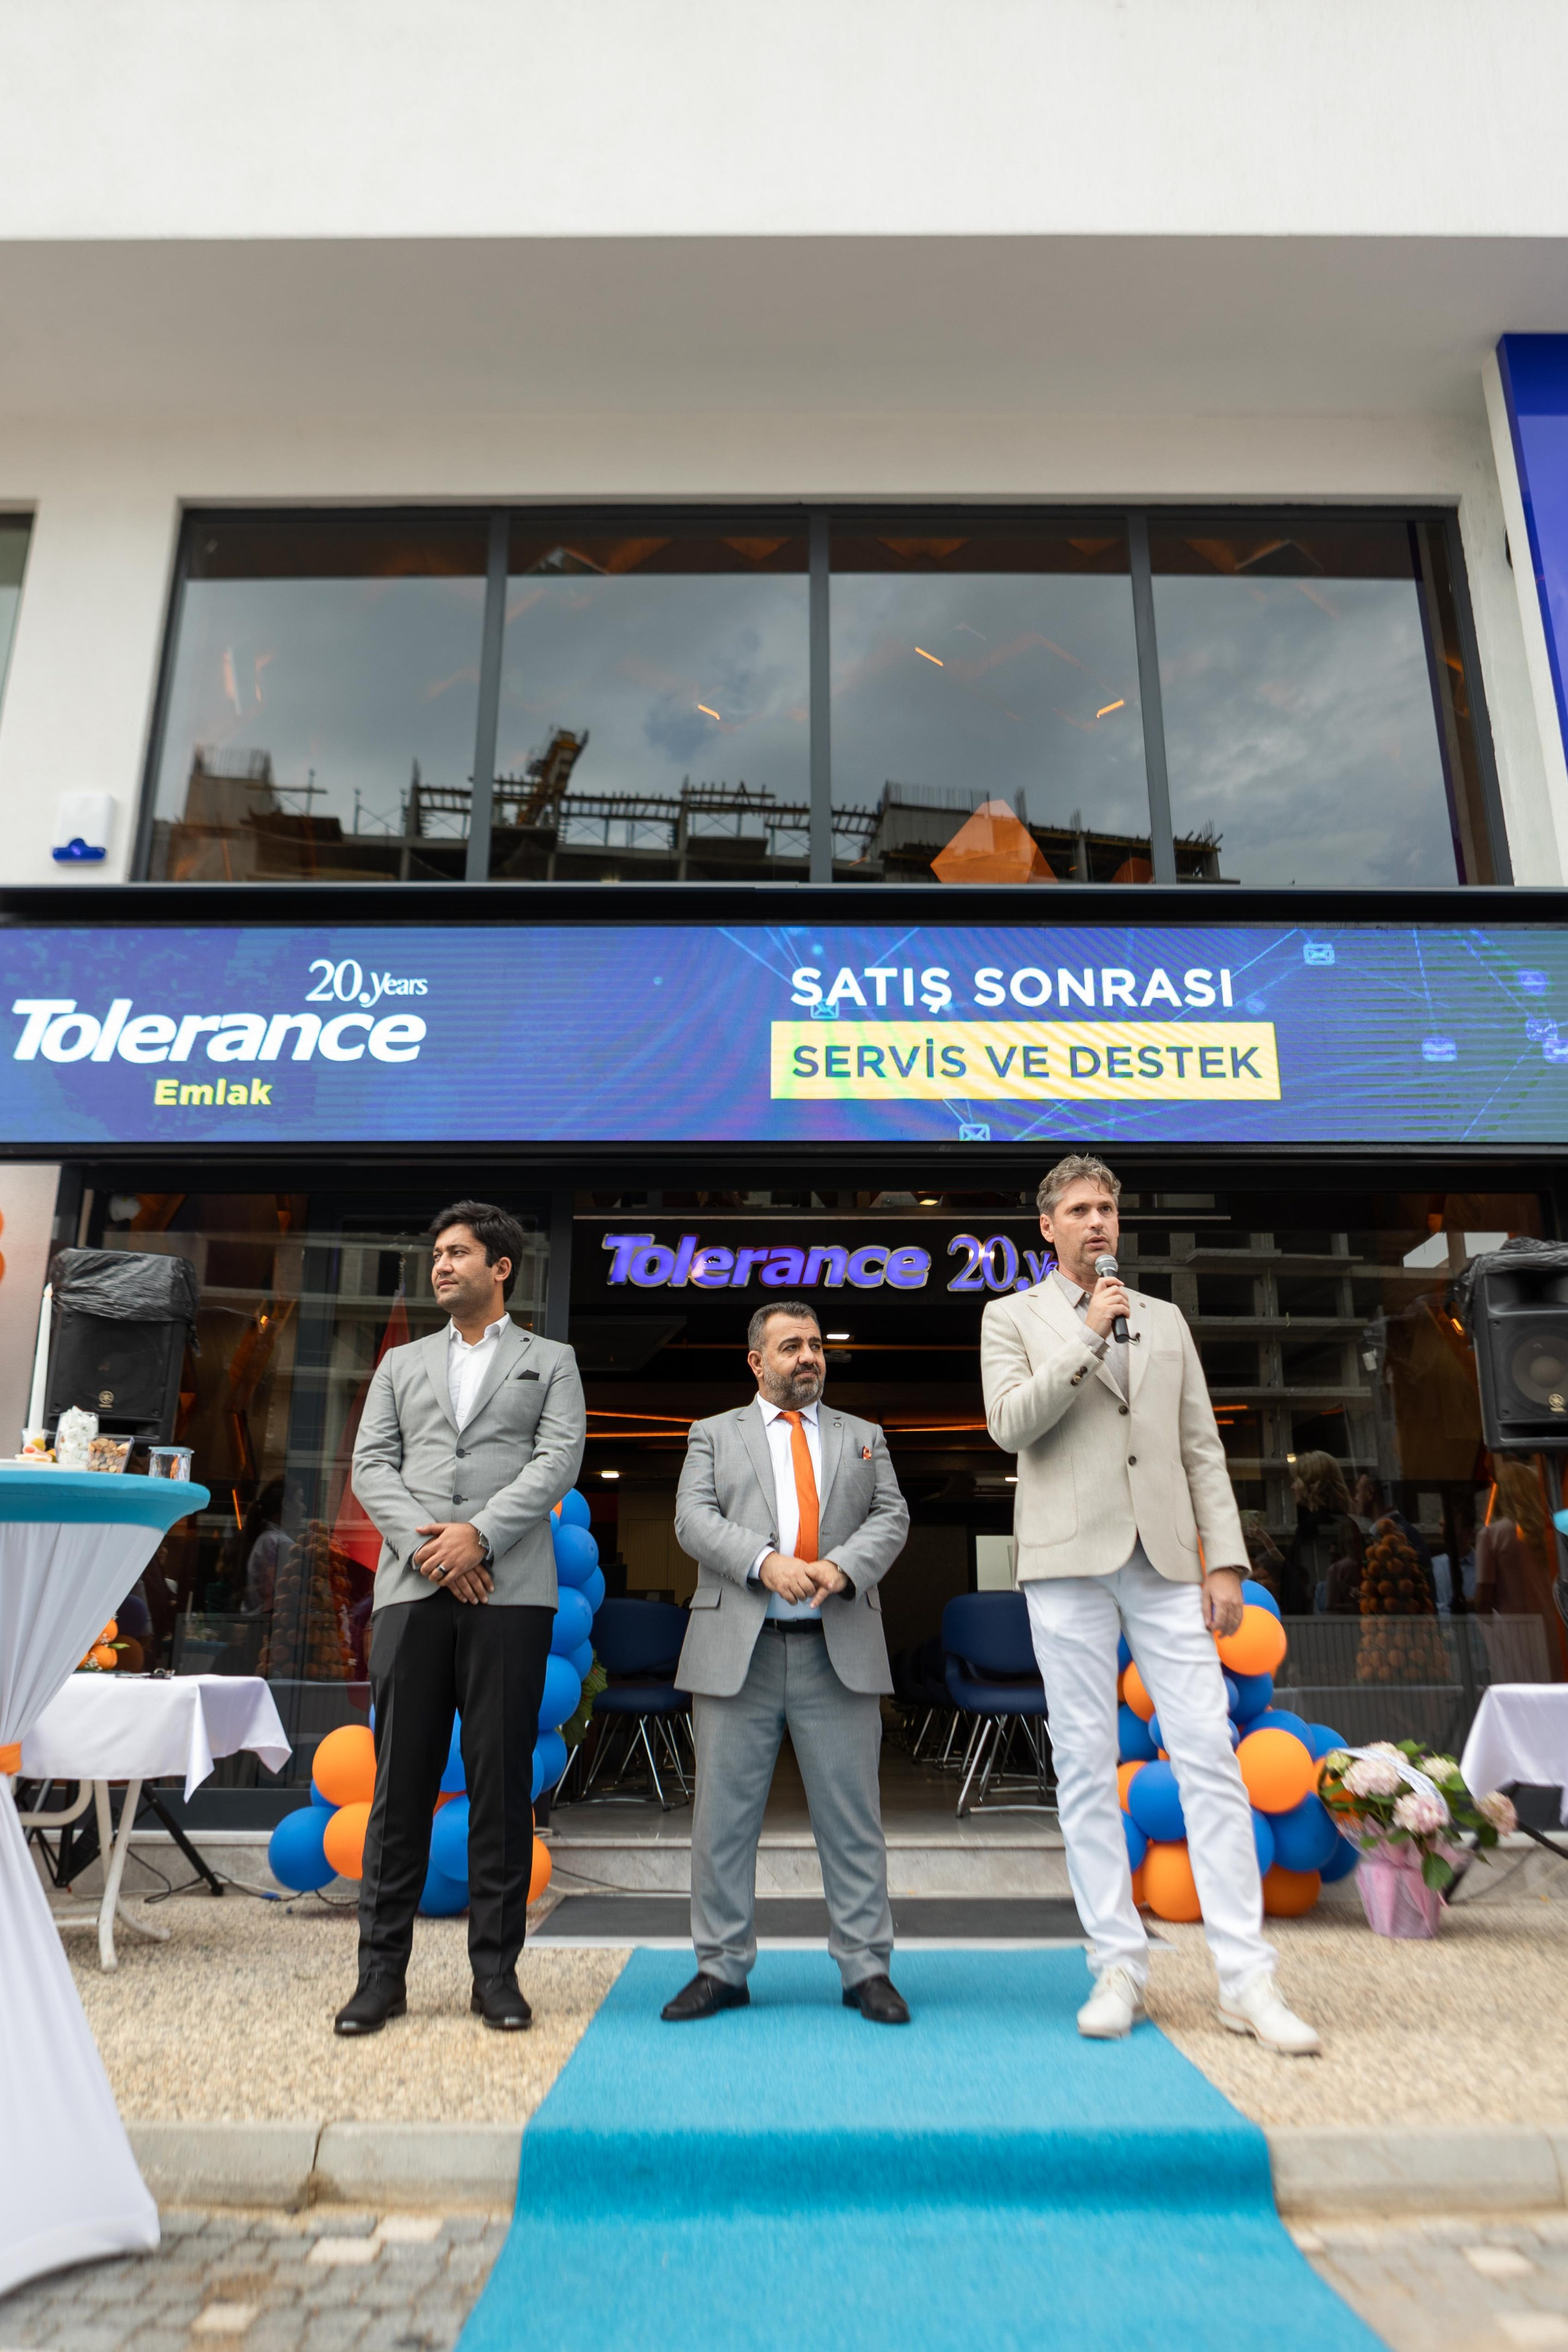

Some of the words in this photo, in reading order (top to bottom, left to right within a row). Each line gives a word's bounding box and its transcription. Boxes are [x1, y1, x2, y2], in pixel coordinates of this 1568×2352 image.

[791, 968, 952, 1014] SATIŞ
[974, 968, 1234, 1008] SONRASI
[12, 998, 427, 1063] Tolerance
[792, 1038, 967, 1078] SERVİS
[985, 1046, 1049, 1078] VE
[1070, 1046, 1263, 1079] DESTEK
[154, 1078, 273, 1105] Emlak
[601, 1234, 931, 1289] Tolerance
